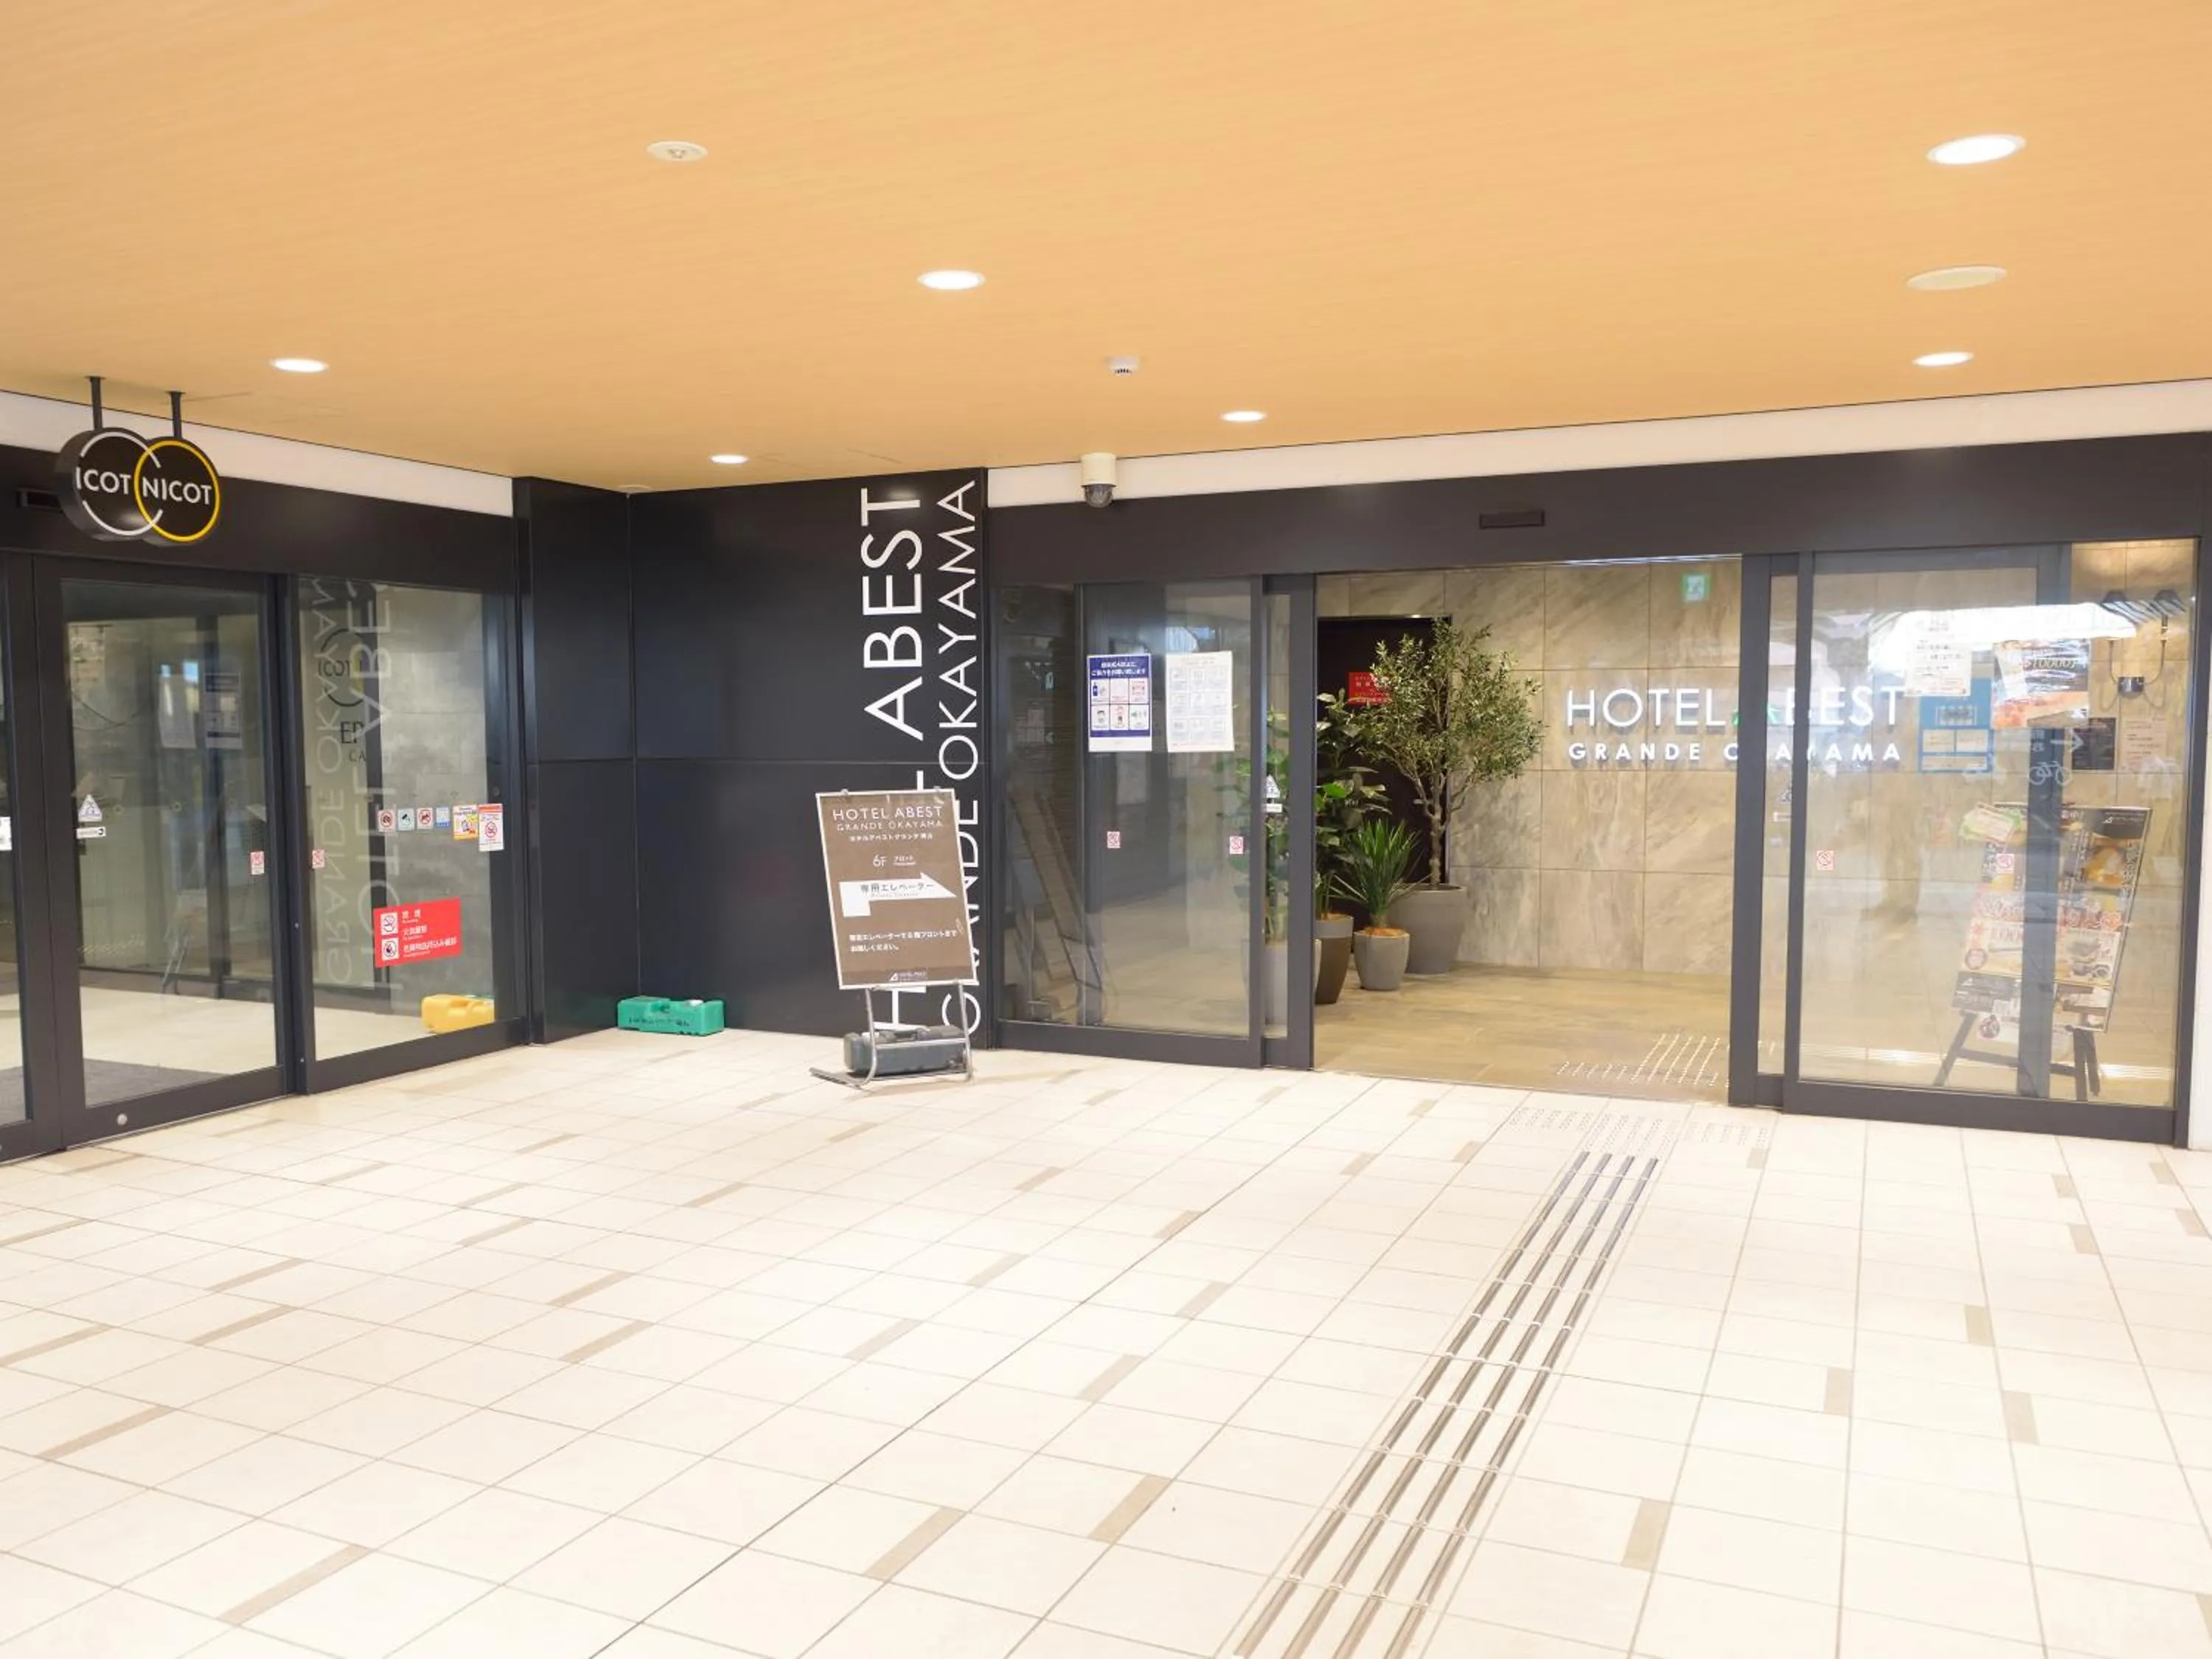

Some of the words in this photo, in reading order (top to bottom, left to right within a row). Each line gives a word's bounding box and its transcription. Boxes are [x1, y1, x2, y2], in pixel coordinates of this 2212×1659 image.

[142, 476, 212, 505] NICOT
[860, 487, 924, 741] ABEST
[937, 480, 978, 779] OKAYAMA
[1567, 689, 1726, 726] HOTEL
[1568, 742, 1700, 760] GRANDE
[832, 807, 889, 821] HOTEL
[894, 806, 943, 818] ABEST
[837, 821, 884, 831] GRANDE
[888, 820, 943, 830] OKAYAMA
